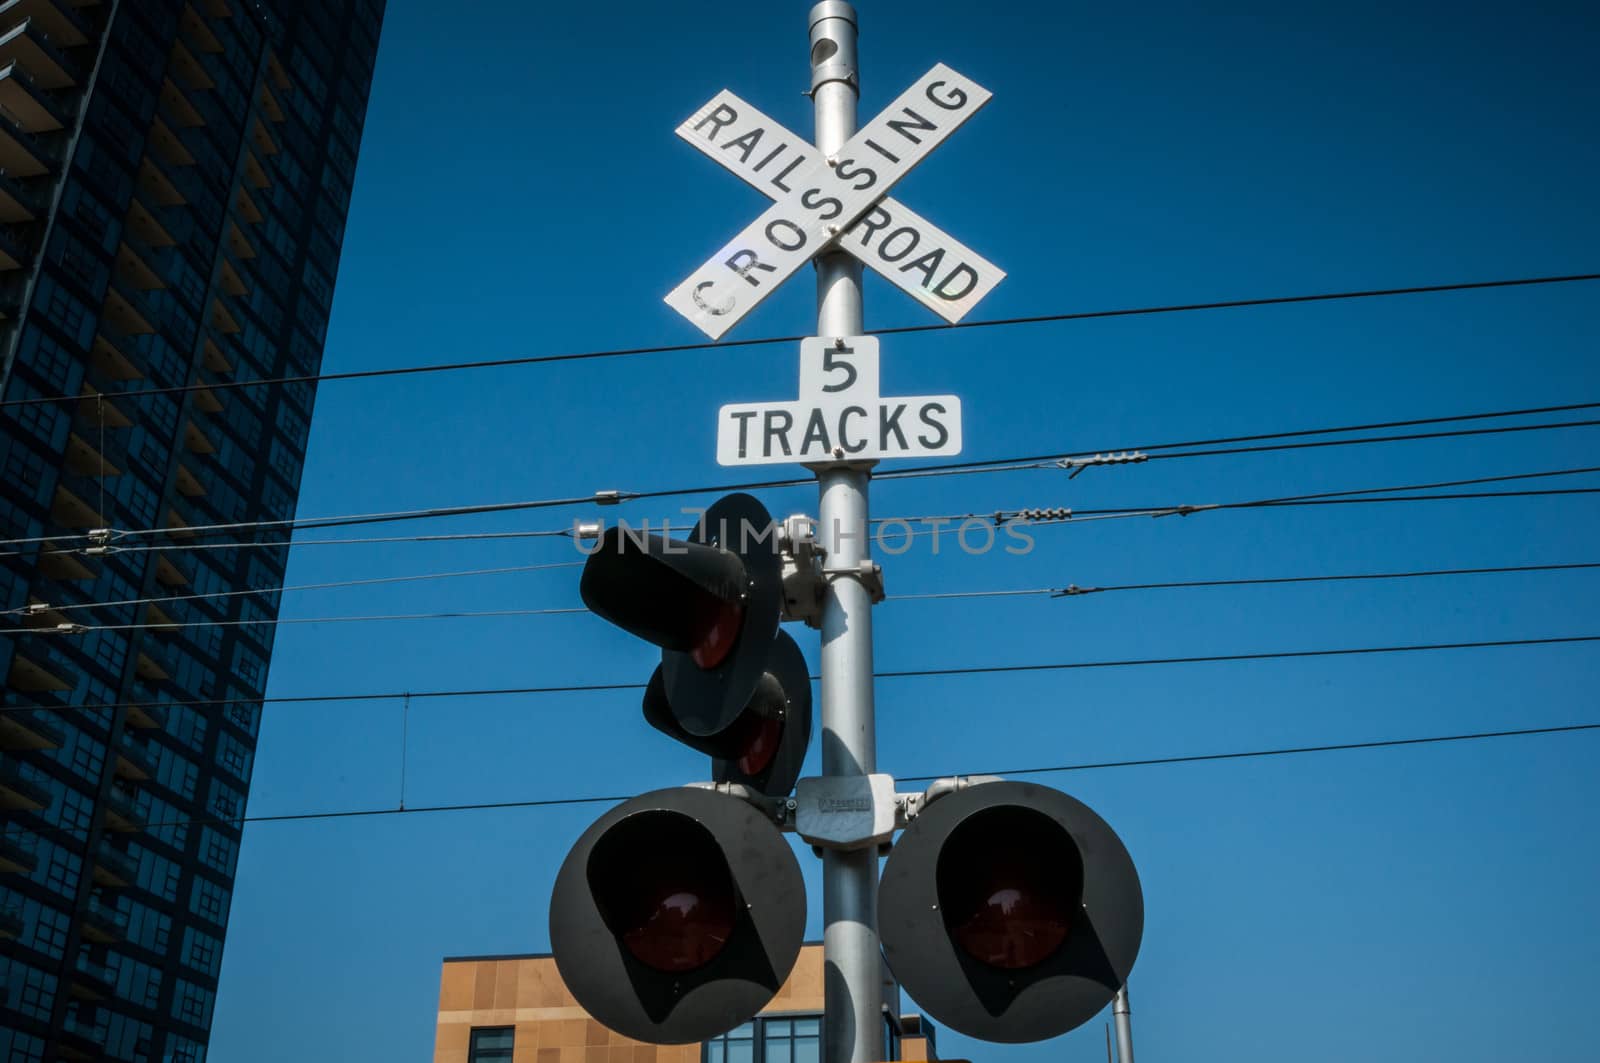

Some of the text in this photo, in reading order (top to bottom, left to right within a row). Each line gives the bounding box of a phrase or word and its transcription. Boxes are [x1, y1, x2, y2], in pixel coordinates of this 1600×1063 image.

[692, 80, 968, 316] CROSSING
[694, 103, 979, 301] RAIL ROAD
[730, 402, 949, 459] TRACKS
[822, 347, 858, 393] 5
